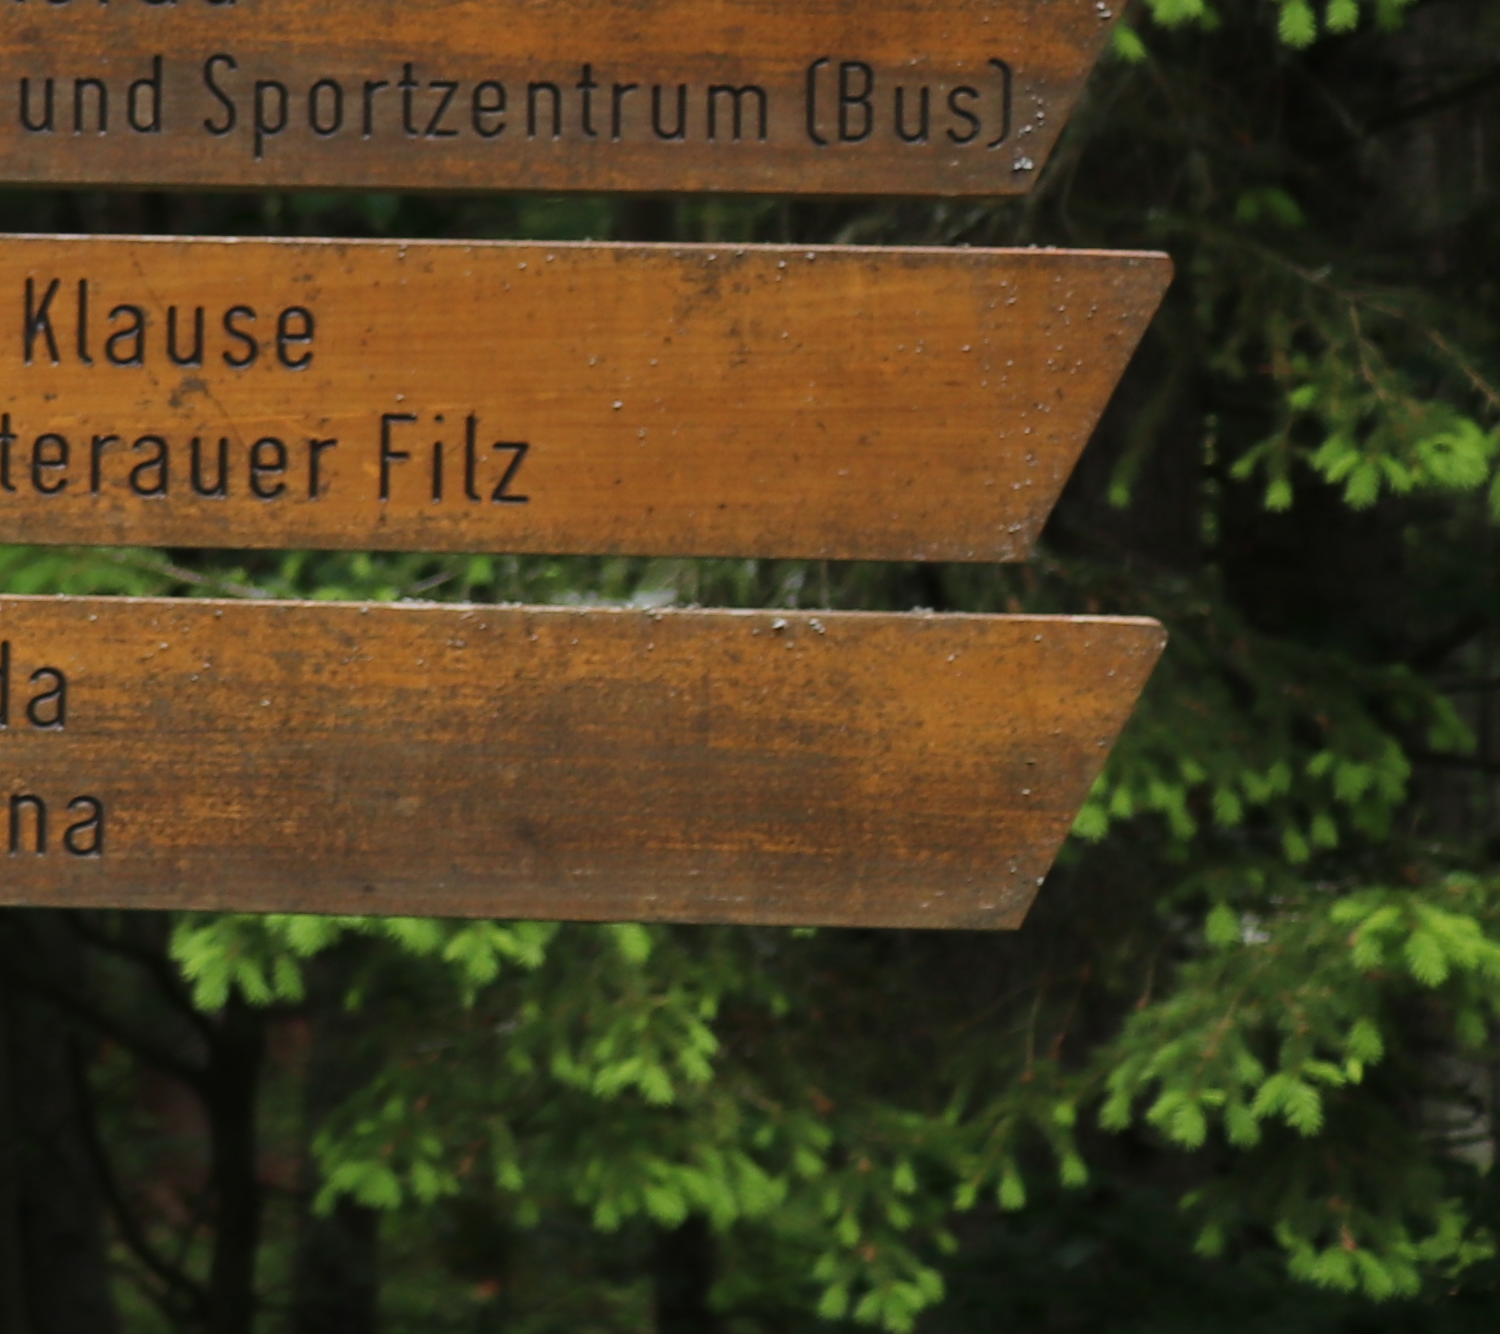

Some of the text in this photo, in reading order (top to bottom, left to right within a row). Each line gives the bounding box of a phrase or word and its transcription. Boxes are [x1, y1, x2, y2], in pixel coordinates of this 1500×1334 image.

[18, 53, 164, 137] und
[203, 52, 769, 162] Sportzentrum
[805, 57, 1014, 151] (Bus)
[23, 276, 316, 370] Klause
[377, 413, 530, 504] Filz
